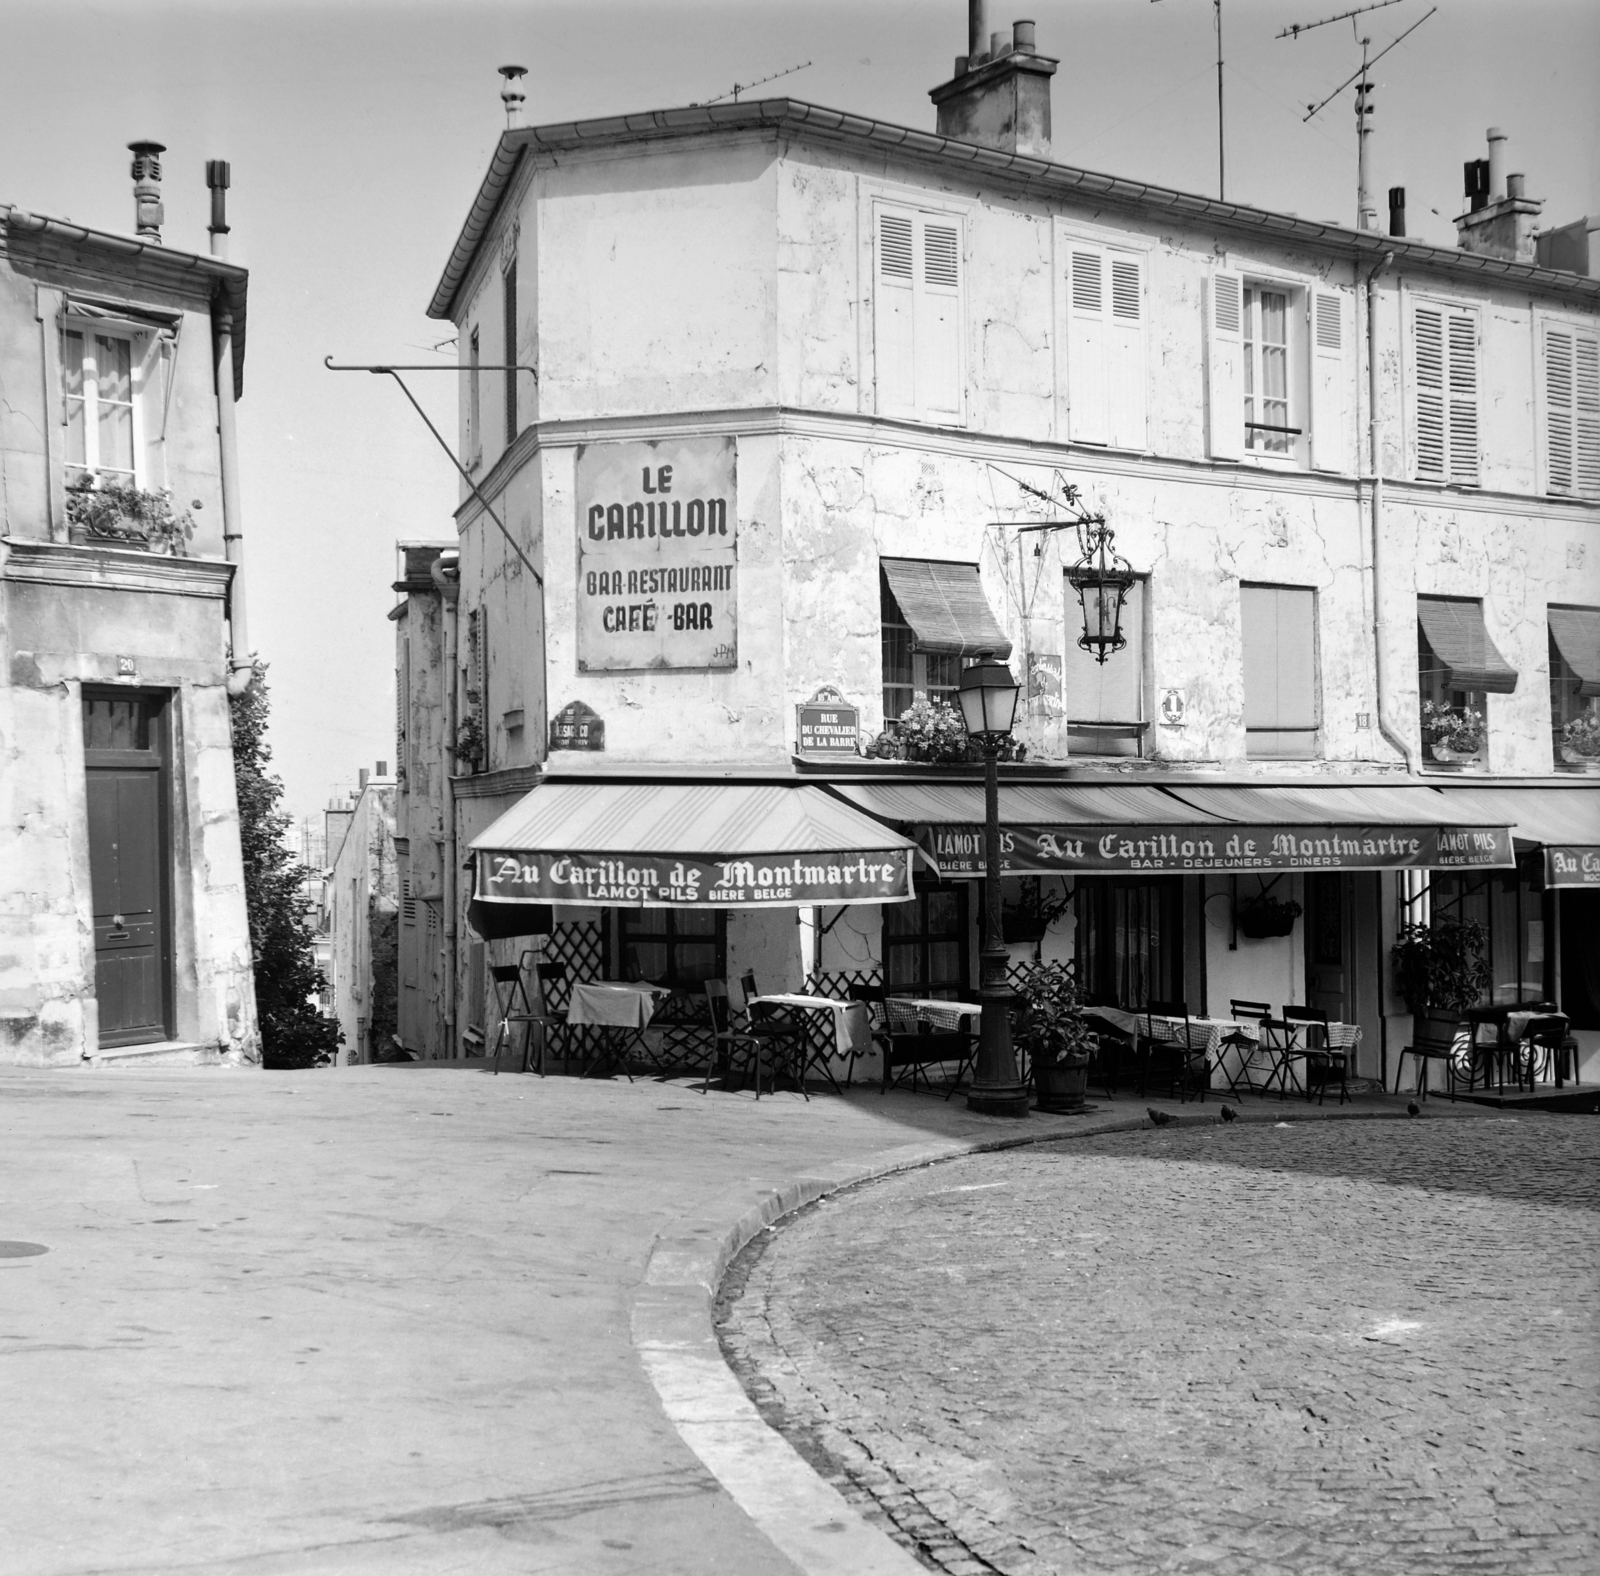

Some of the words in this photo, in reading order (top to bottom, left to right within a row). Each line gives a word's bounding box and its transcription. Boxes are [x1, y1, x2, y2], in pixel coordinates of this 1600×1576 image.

[642, 465, 673, 494] LE
[588, 498, 728, 541] CARILLON
[586, 565, 734, 596] BAR-RESTAURANT
[120, 658, 134, 671] 20
[820, 713, 838, 723] RUE
[1358, 715, 1367, 727] 18
[801, 725, 813, 735] DU
[814, 725, 856, 736] CHEVALIER
[802, 737, 814, 747] DE
[816, 737, 828, 747] LA
[829, 737, 856, 747] BARRE
[937, 833, 980, 855] LAMOT
[1036, 833, 1085, 858] Au
[1098, 833, 1215, 859] Carillon
[1225, 834, 1258, 857] de
[1268, 833, 1420, 857] Montmartre
[1436, 833, 1469, 851] LAMOT
[1472, 832, 1496, 851] PILS
[939, 860, 973, 871] BIÈRE
[1130, 859, 1164, 868] BAR
[1183, 857, 1273, 868] DÉJEUNERS
[1553, 852, 1578, 873] Au
[487, 857, 541, 884] Au
[549, 858, 660, 885] Carillon
[669, 861, 703, 888] de
[713, 858, 896, 889] Montmartre
[587, 885, 651, 900] LAMOT
[658, 886, 699, 901] PILS
[708, 888, 746, 901] BIÈRE
[753, 887, 793, 900] BELGE
